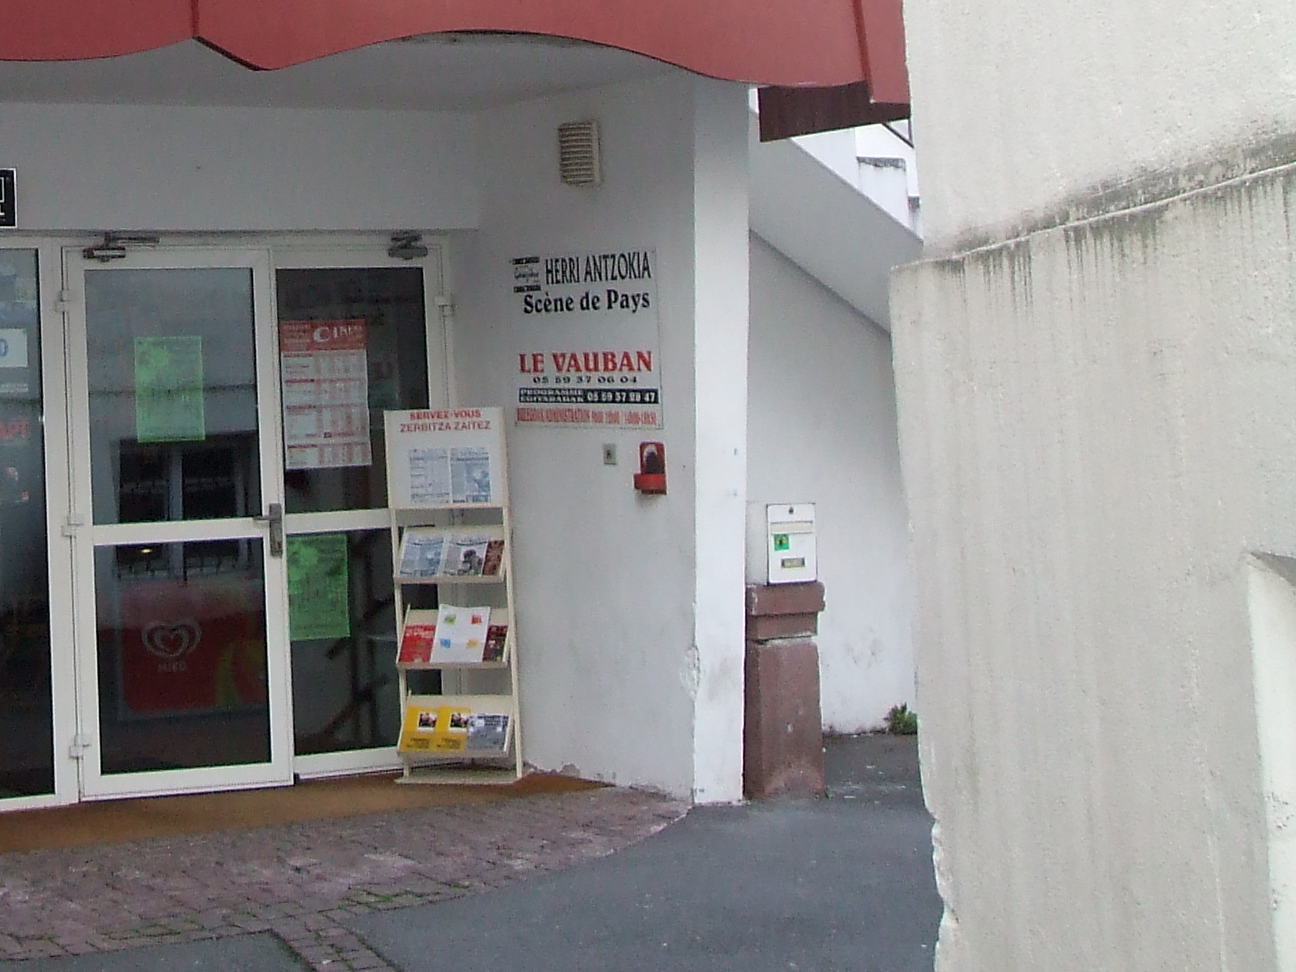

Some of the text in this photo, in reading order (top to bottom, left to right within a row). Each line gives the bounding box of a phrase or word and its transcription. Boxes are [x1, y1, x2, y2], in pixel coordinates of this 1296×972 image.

[545, 257, 580, 285] HERRI
[584, 251, 652, 283] ANTZOKIA
[524, 289, 651, 314] Scène de Pays
[518, 350, 653, 374] LE VAUBAN
[533, 375, 549, 384] 05
[586, 391, 598, 403] 05
[644, 391, 655, 403] 47
